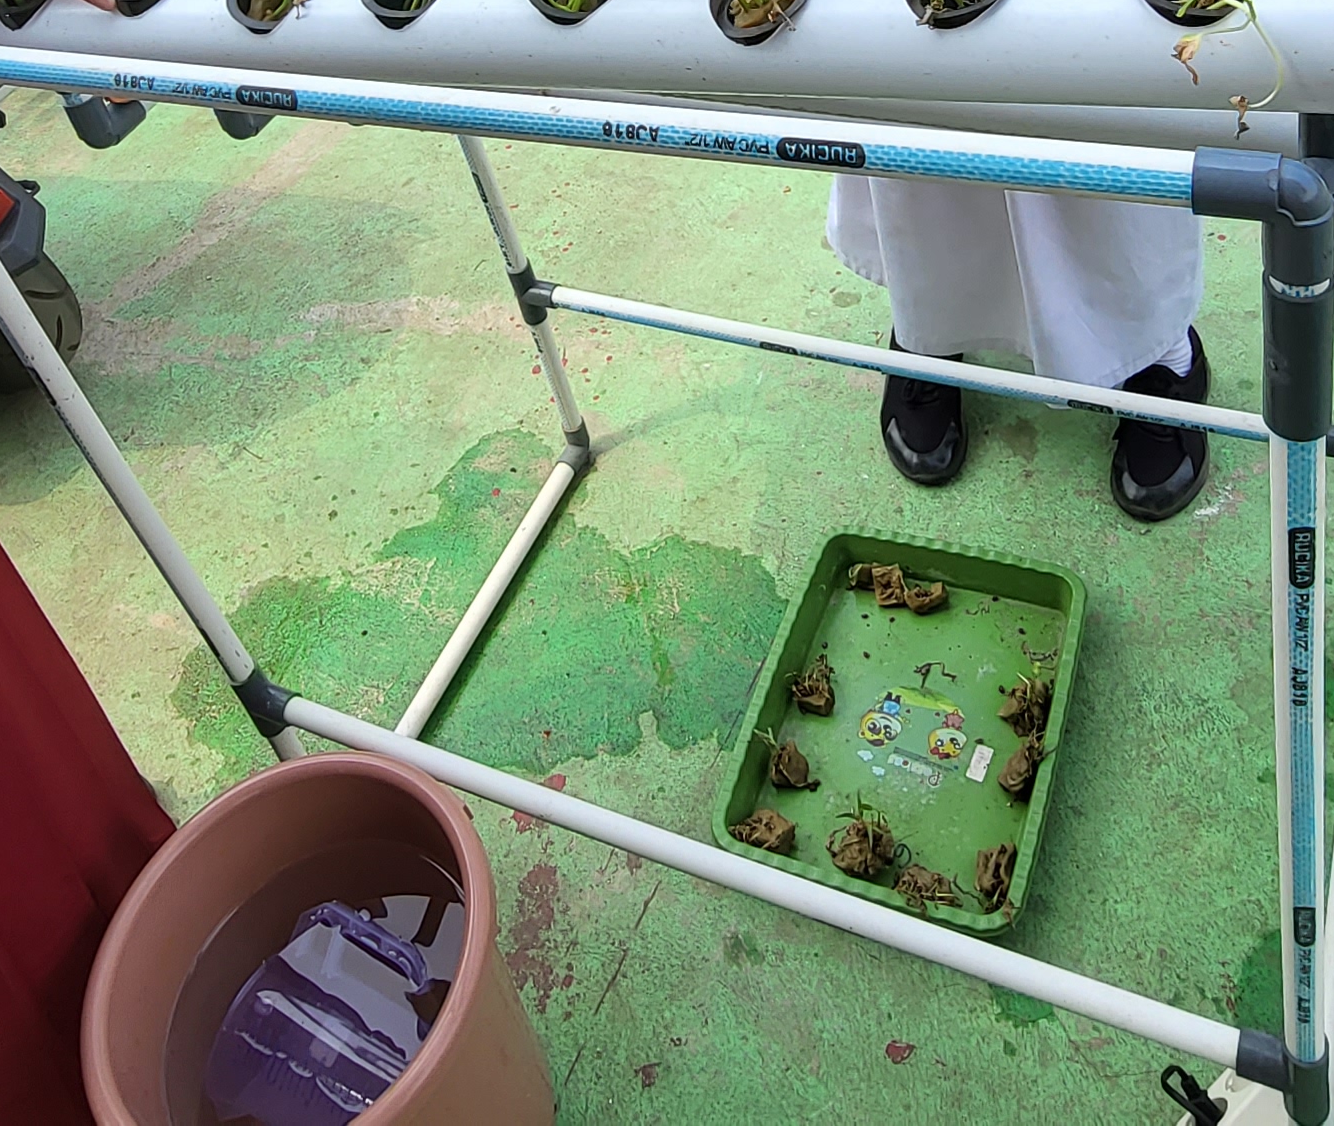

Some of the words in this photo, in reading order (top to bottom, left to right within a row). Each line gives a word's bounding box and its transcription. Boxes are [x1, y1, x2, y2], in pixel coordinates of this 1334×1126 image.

[241, 88, 293, 107] RUCIKA
[712, 135, 736, 152] AW
[738, 138, 771, 155] PVC
[784, 142, 858, 164] RUCIKA
[1294, 532, 1311, 583] RUCIKA
